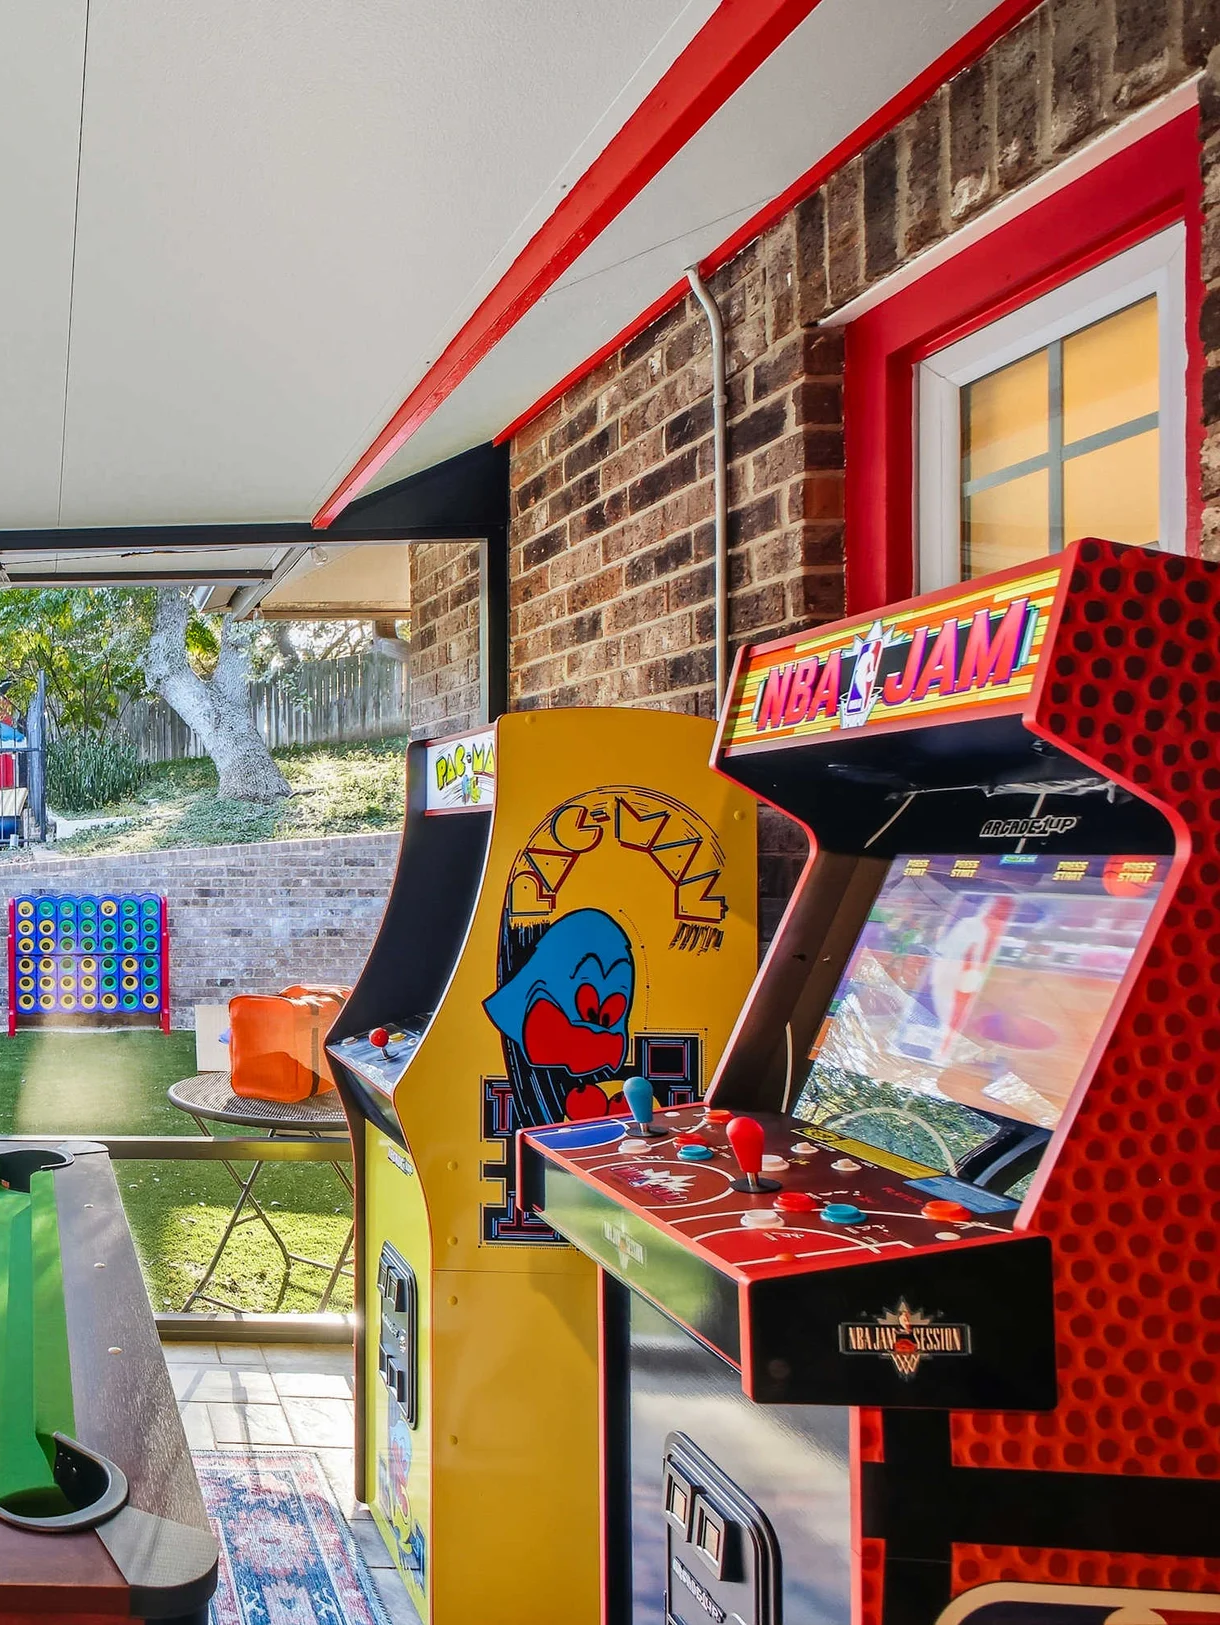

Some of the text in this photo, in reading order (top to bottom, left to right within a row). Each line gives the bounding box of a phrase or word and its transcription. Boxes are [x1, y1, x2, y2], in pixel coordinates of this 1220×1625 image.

[756, 598, 1030, 731] NBA JAM
[436, 743, 495, 791] PAC-MA
[903, 868, 927, 876] START
[949, 868, 977, 878] START
[1052, 871, 1086, 881] START
[1116, 872, 1153, 883] START
[848, 1326, 872, 1350] NBA
[913, 1327, 961, 1351] SESSION
